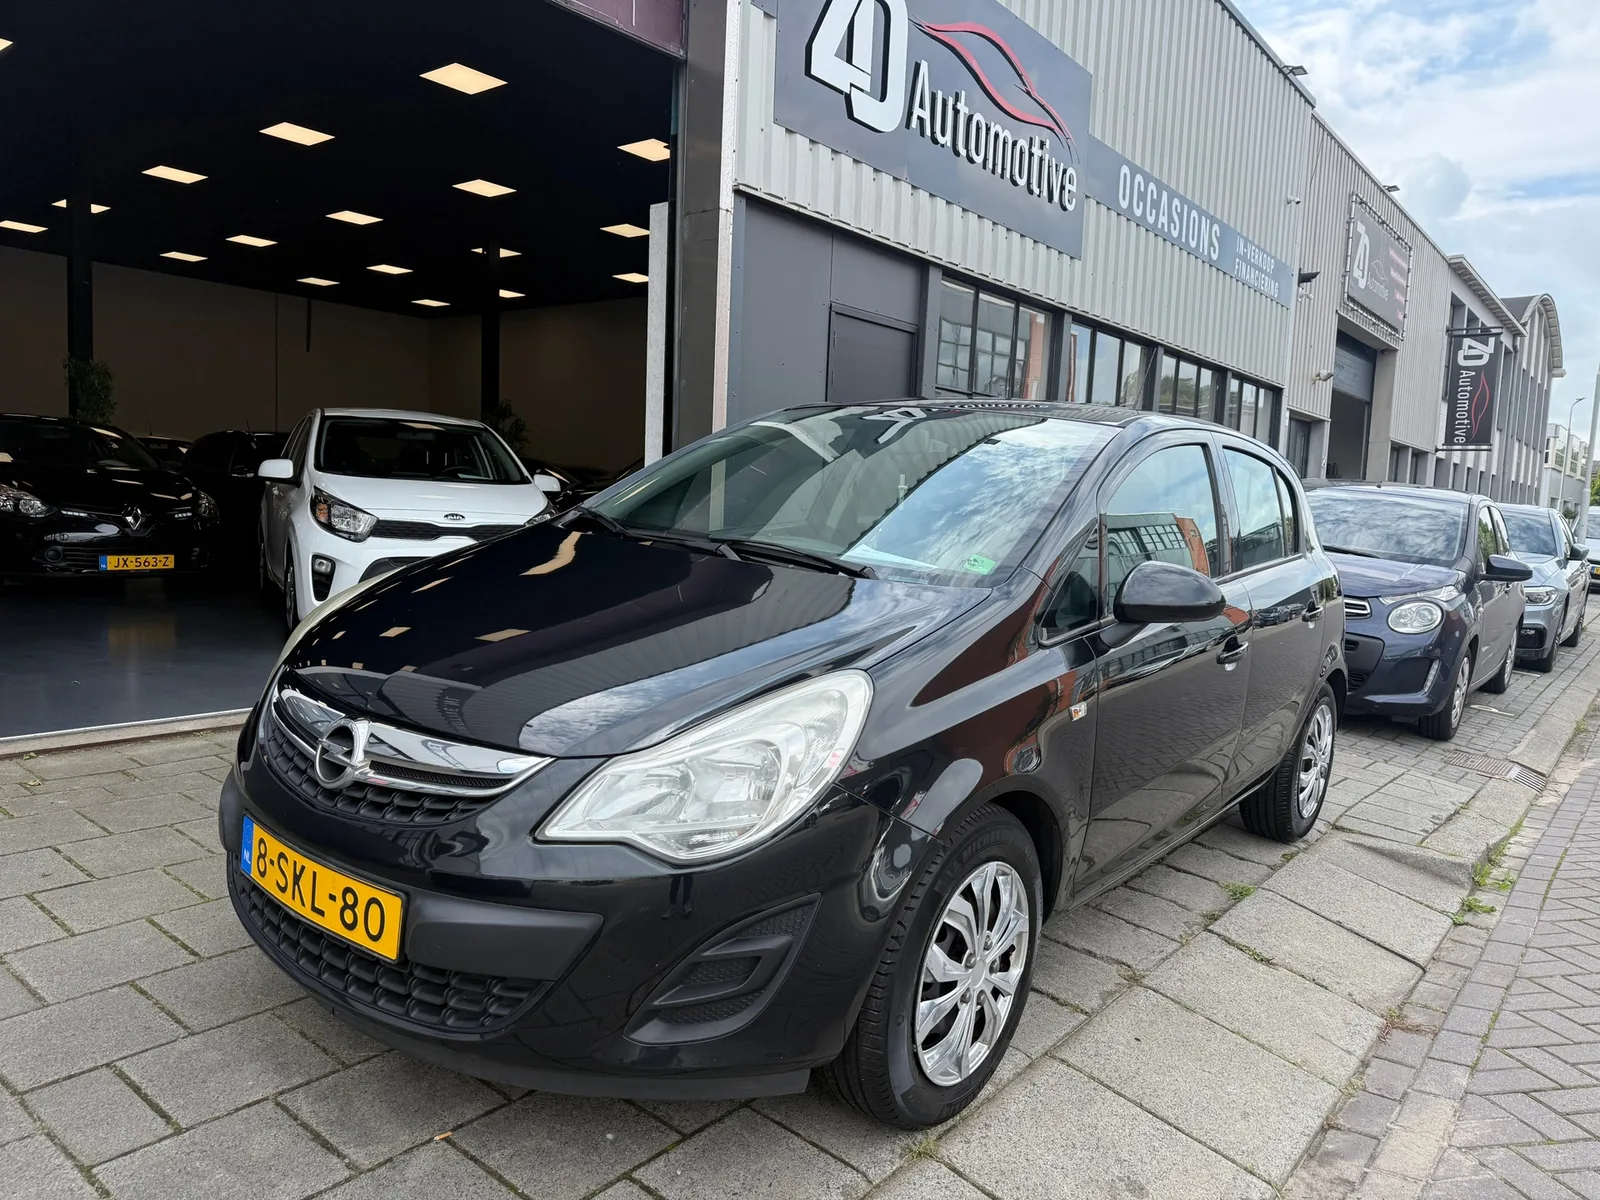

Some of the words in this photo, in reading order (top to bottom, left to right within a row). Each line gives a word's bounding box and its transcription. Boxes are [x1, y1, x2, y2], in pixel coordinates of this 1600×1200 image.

[909, 59, 1077, 211] Automotive
[1118, 164, 1220, 261] OCCASIONS
[1235, 258, 1279, 298] FINANCIERING
[1236, 236, 1275, 274] IN-VERKOOP
[1454, 370, 1476, 444] Automotive
[114, 556, 169, 568] JX-563-Z
[243, 848, 251, 865] NL
[256, 837, 386, 943] 8-SKL-80
